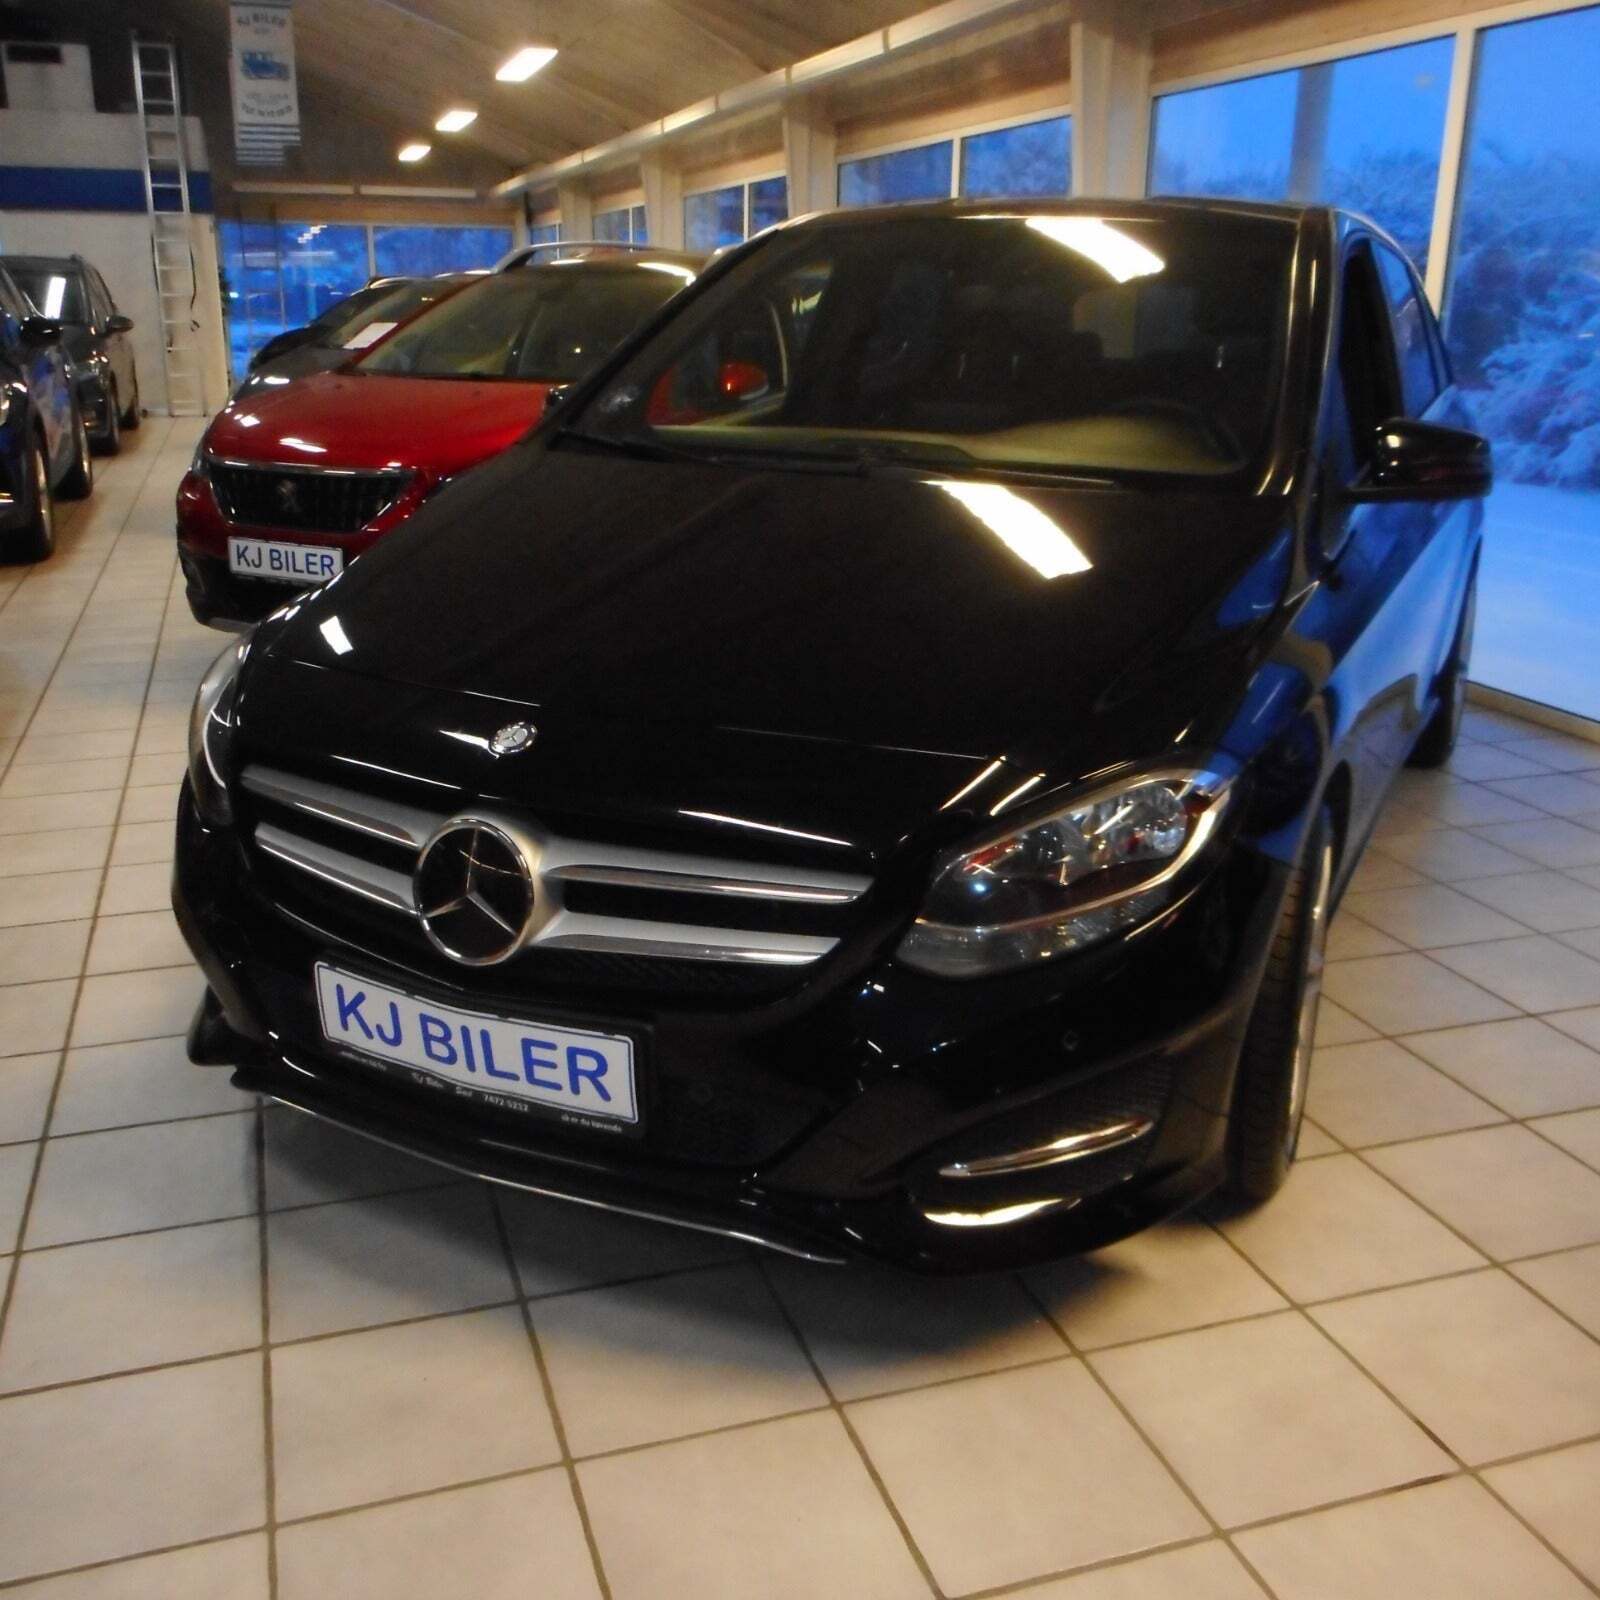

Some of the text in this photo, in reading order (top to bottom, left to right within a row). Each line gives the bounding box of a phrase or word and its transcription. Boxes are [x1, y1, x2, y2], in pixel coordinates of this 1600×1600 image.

[236, 544, 335, 577] KJ BILER
[335, 983, 612, 1102] KJ BILER
